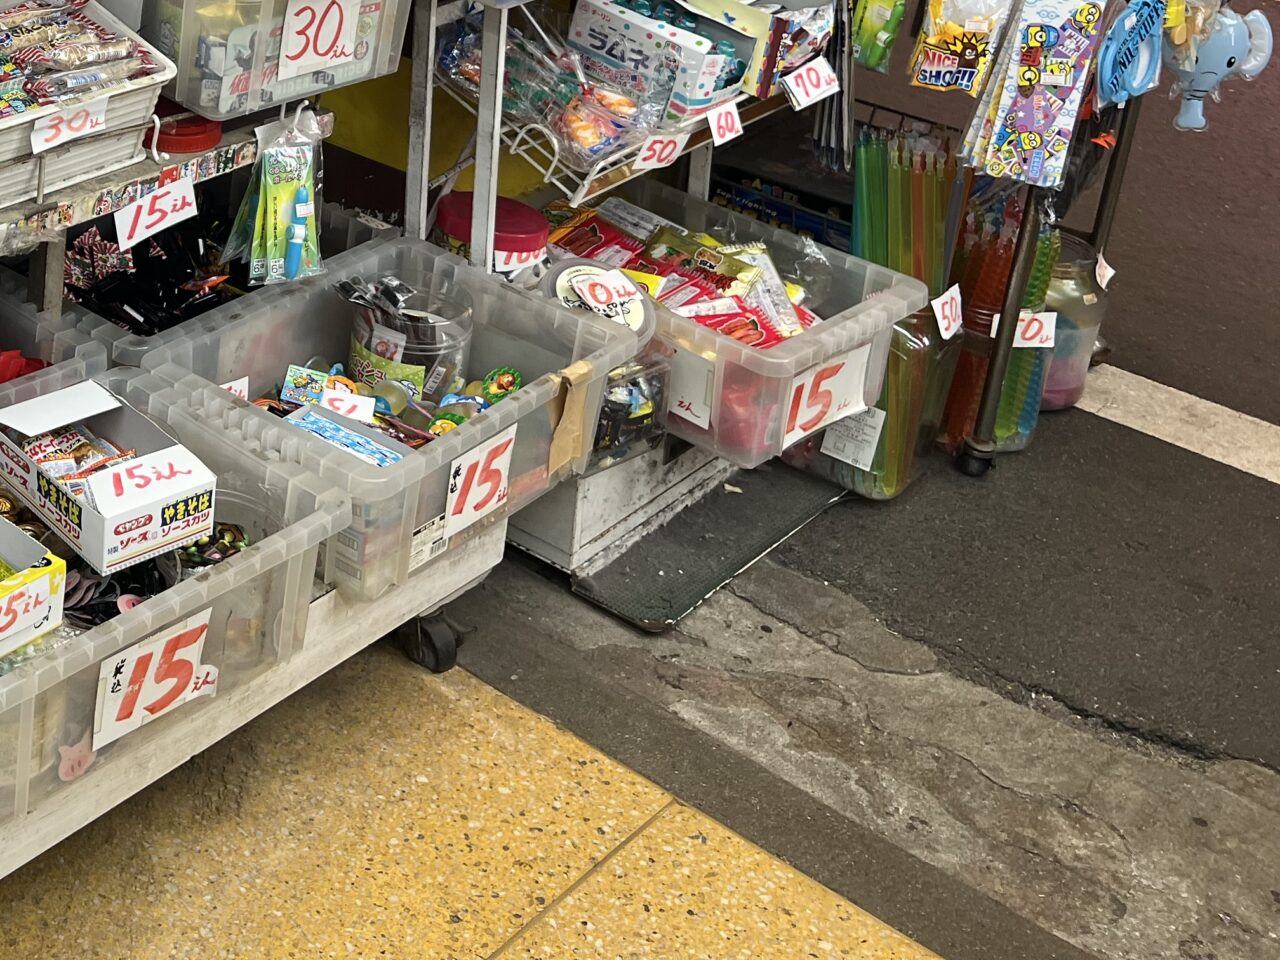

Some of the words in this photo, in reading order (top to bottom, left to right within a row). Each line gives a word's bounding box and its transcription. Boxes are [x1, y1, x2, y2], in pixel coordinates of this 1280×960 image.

[922, 46, 960, 70] NICE
[1018, 316, 1053, 345] 0えん
[111, 462, 193, 498] 15えん
[38, 476, 82, 527] やきそば
[162, 493, 212, 525] やきそば
[38, 495, 82, 541] ソースカツ
[161, 510, 211, 538] ソースカツ
